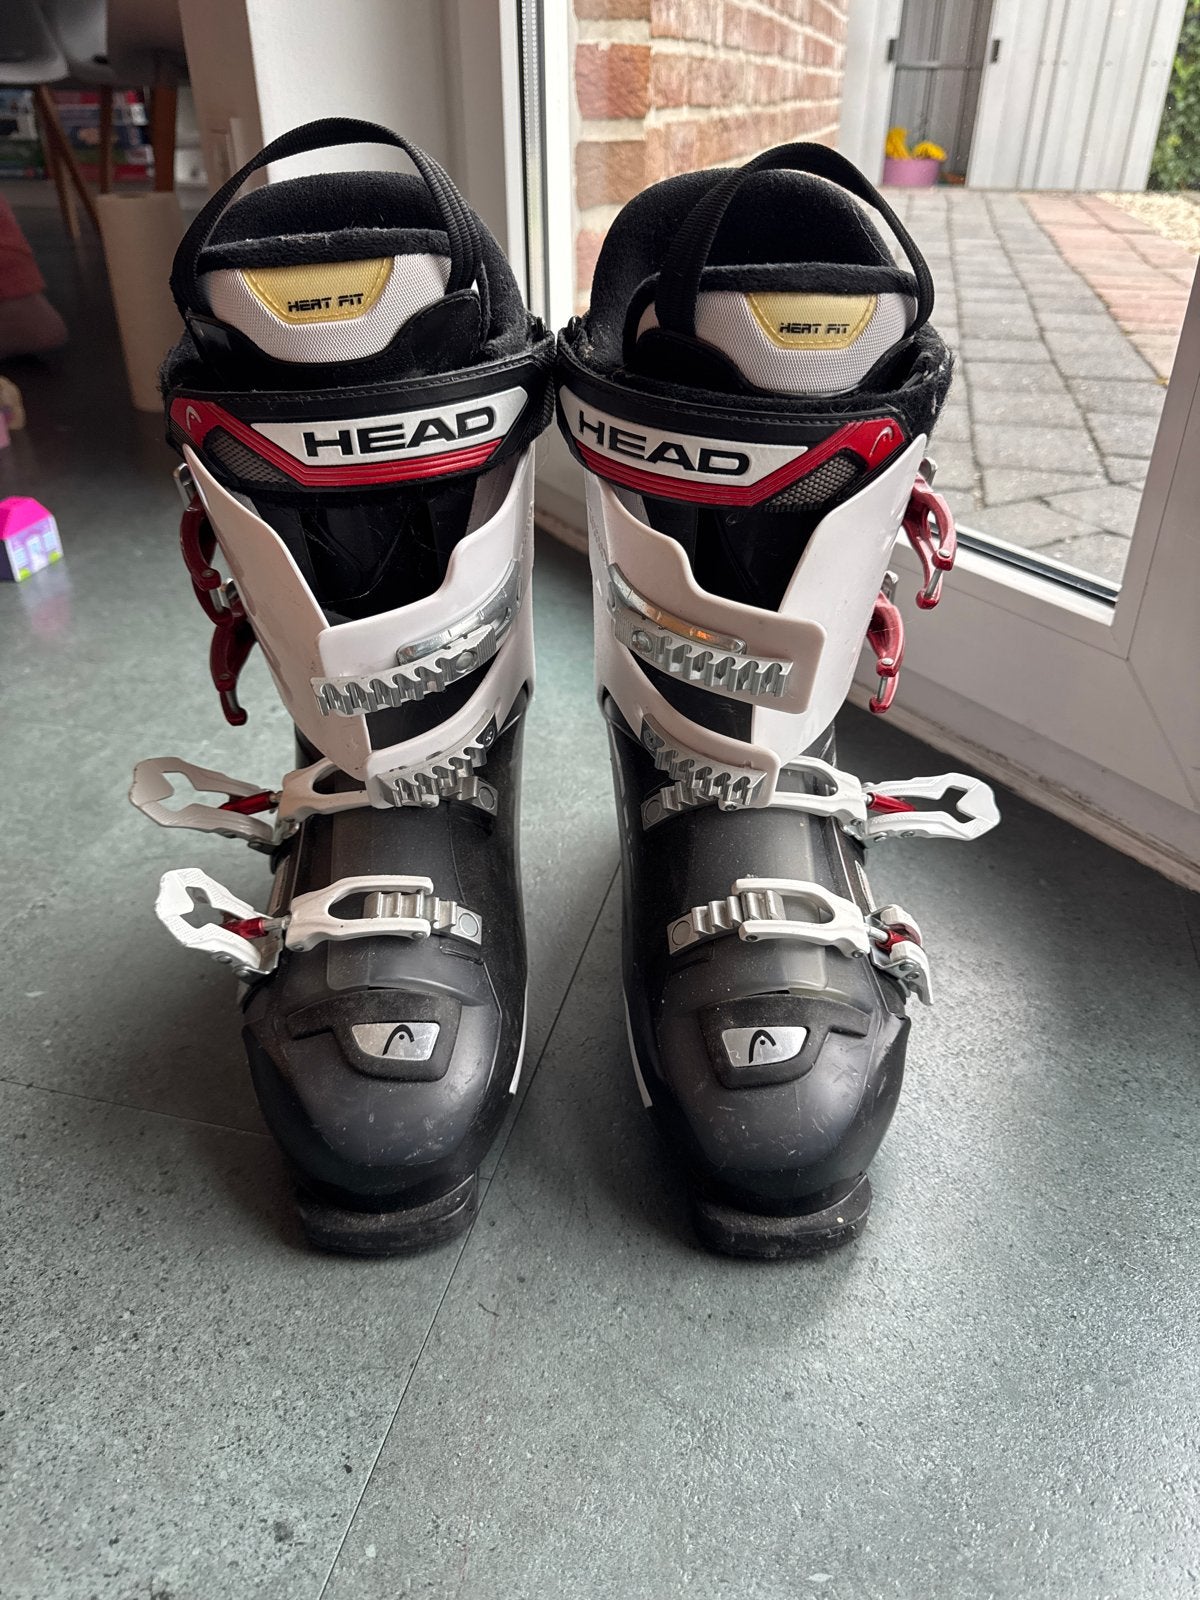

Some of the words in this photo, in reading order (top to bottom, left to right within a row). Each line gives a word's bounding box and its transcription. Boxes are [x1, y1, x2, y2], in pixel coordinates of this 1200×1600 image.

[288, 297, 331, 312] HEAT
[338, 293, 364, 307] FIT
[780, 322, 821, 334] HEAT
[827, 323, 850, 334] FIT
[302, 406, 496, 458] HEAD
[578, 410, 751, 476] HEAD
